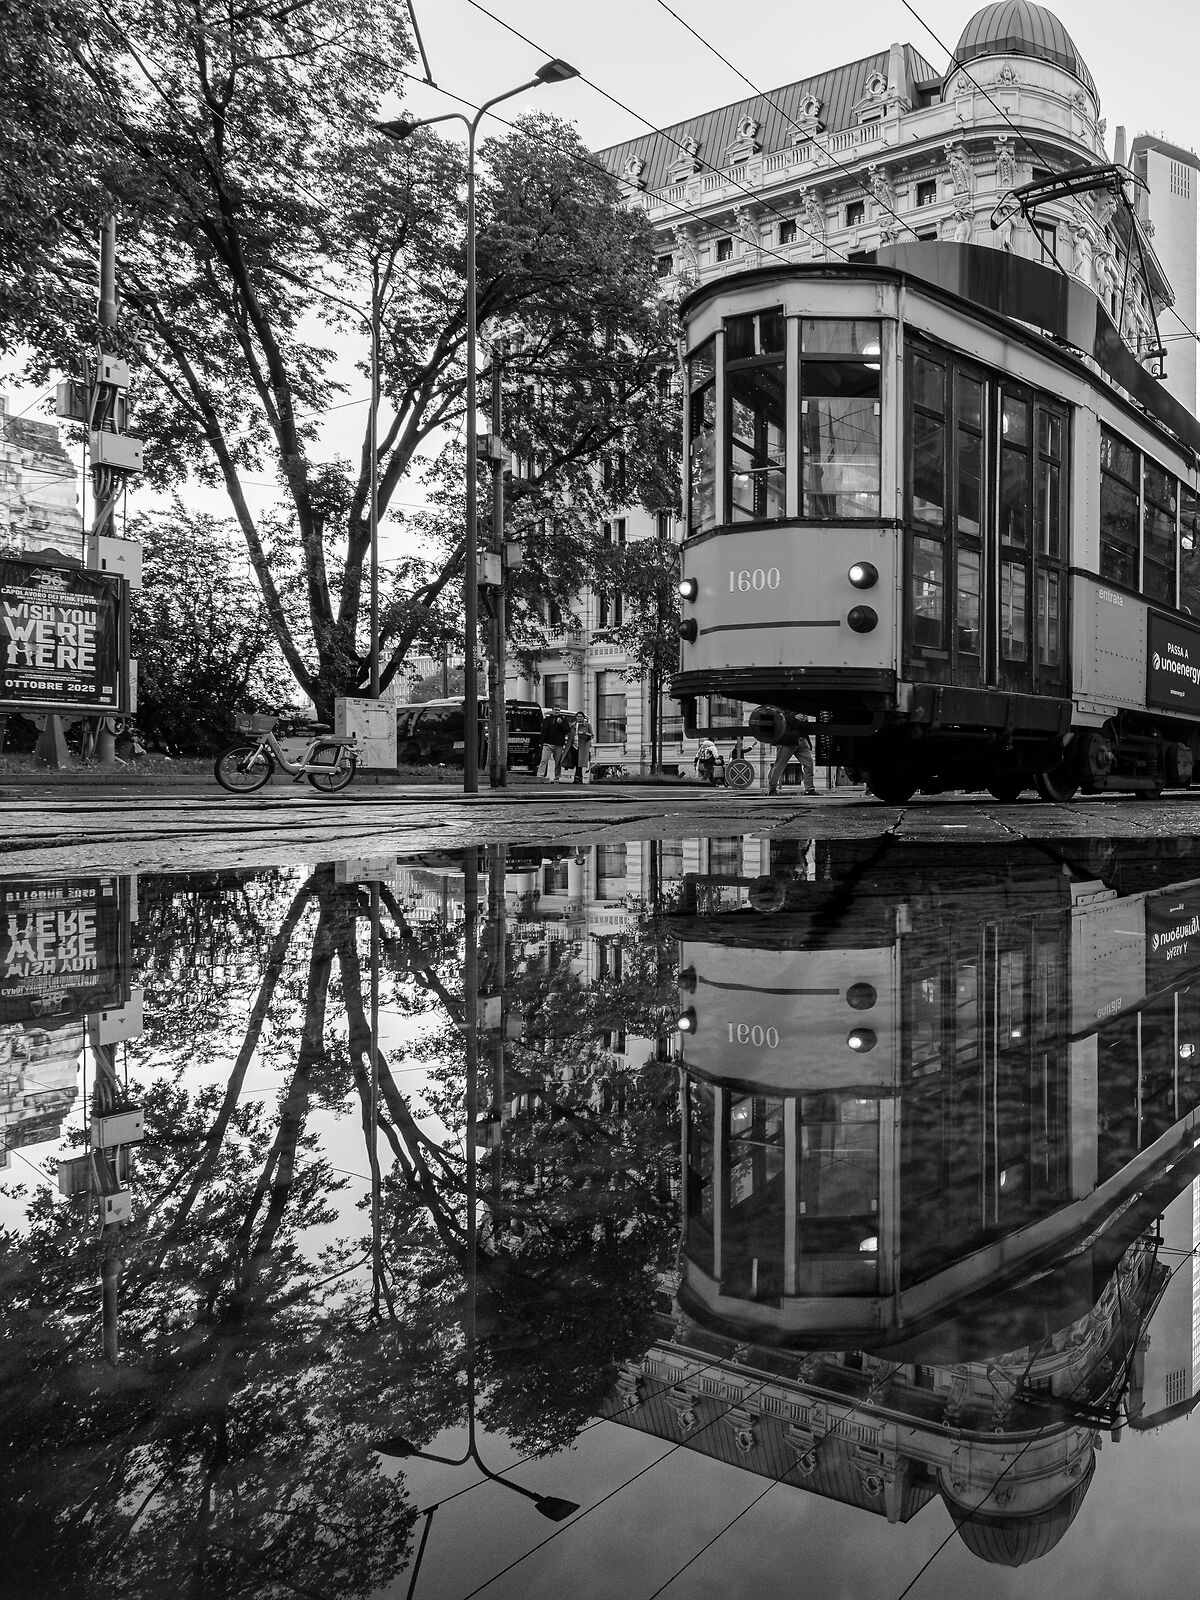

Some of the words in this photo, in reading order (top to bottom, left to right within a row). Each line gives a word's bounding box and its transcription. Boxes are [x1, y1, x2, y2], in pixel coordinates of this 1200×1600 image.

[728, 567, 781, 594] 1600
[0, 587, 47, 599] CAPOLAVORO
[60, 594, 77, 602] PINK
[1099, 589, 1124, 607] entrata
[3, 601, 55, 621] WISH
[59, 607, 97, 625] YOU
[3, 616, 97, 648] WERE
[1167, 642, 1184, 658] PASSA
[1184, 649, 1189, 659] A
[1161, 657, 1200, 685] unoenergy
[5, 680, 63, 691] OTTOBRE
[67, 683, 96, 693] 2025
